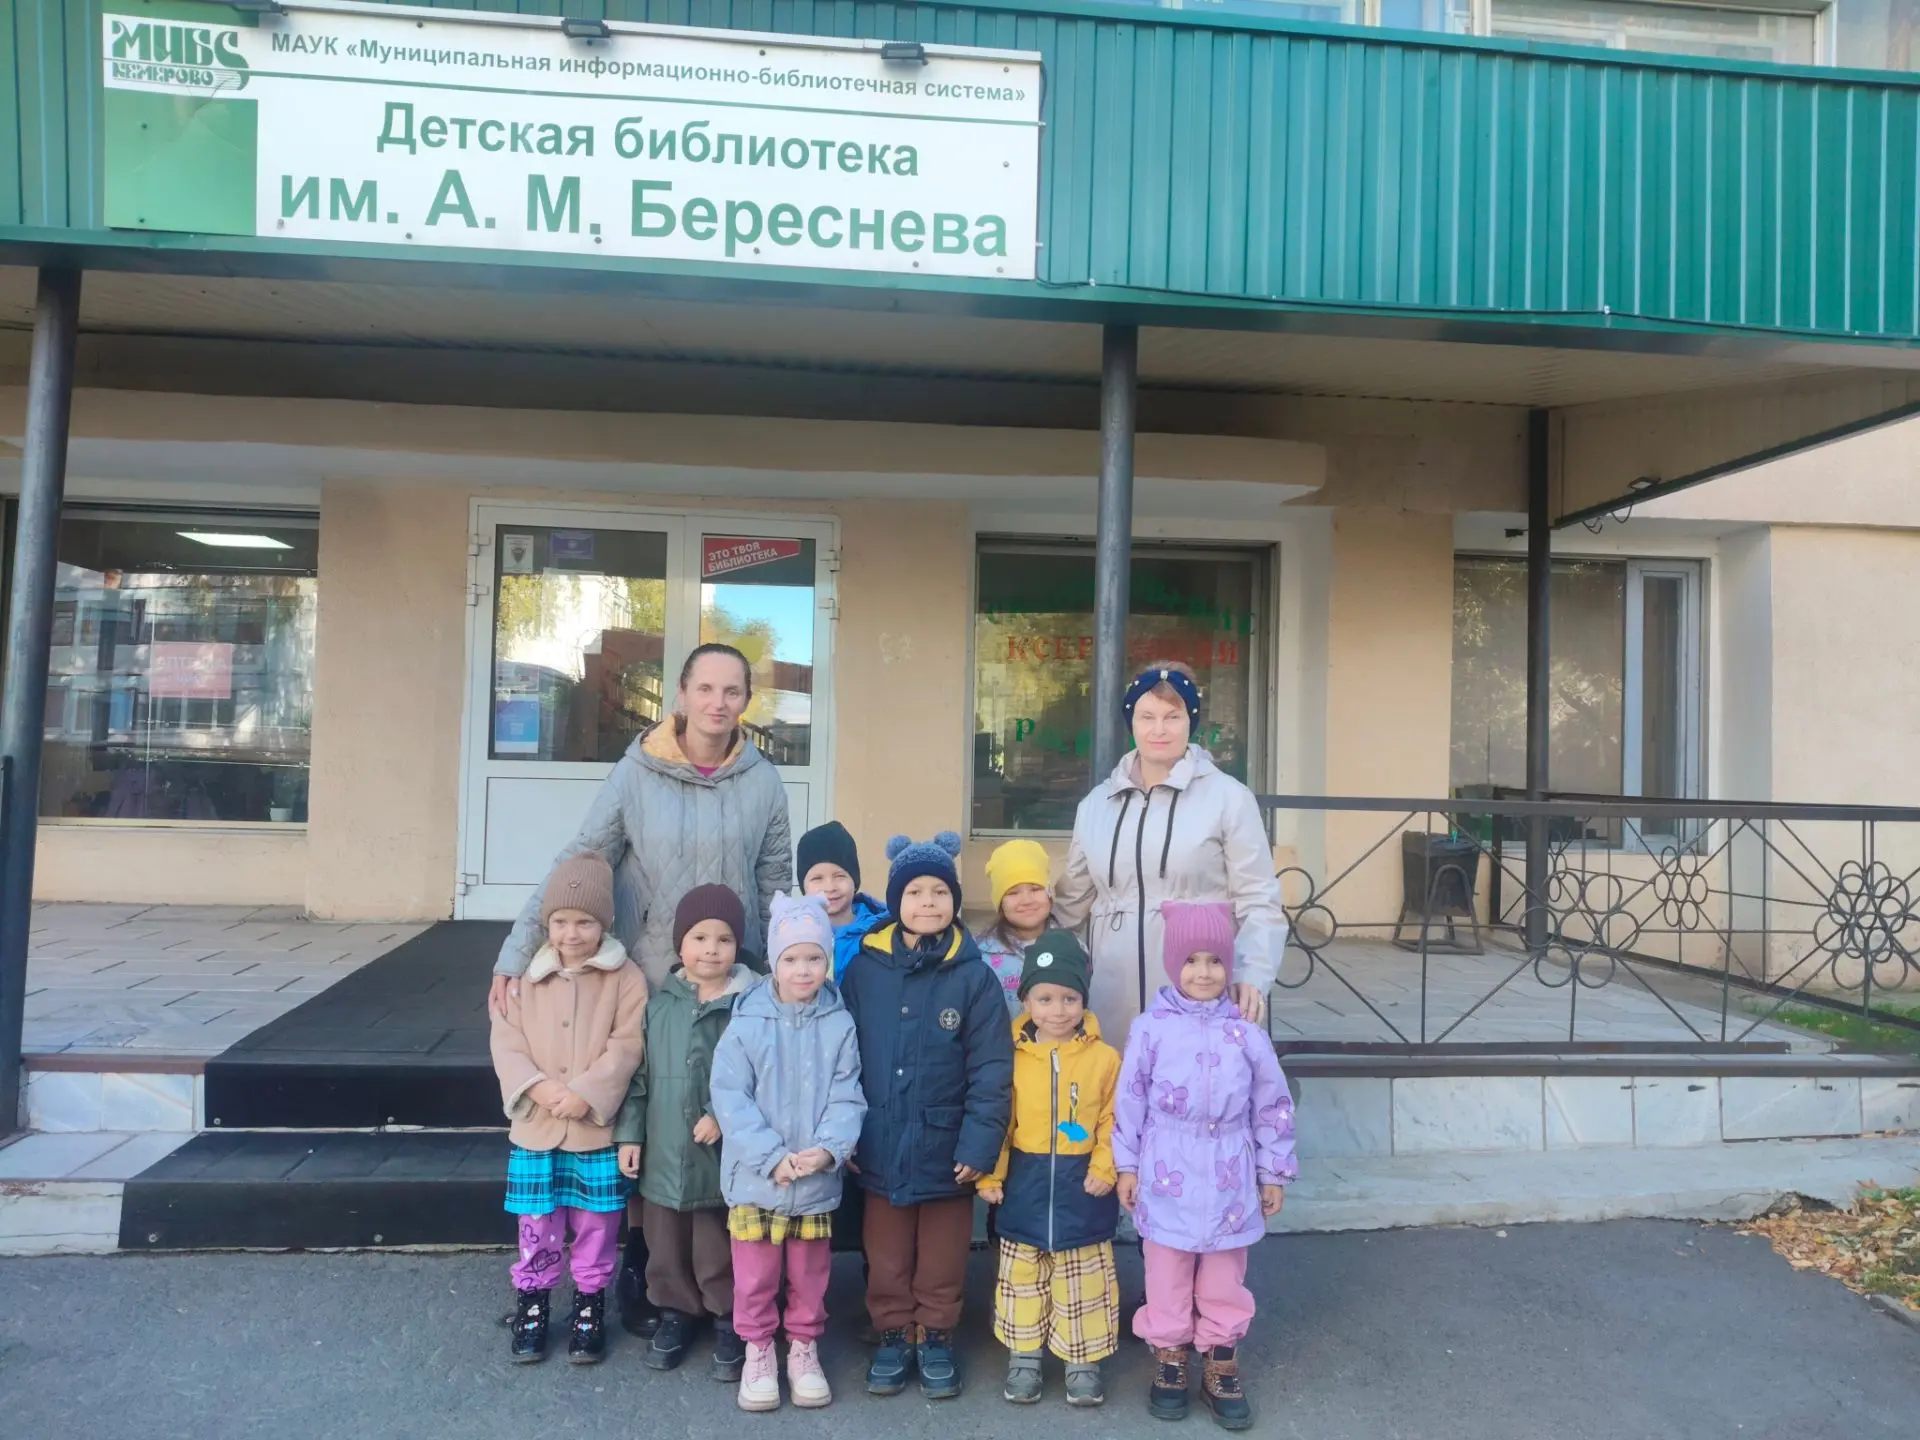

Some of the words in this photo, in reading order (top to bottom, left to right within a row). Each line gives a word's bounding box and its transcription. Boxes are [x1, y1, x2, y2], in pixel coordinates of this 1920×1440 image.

[272, 32, 339, 56] МАУК
[346, 39, 551, 72] «Муниципальная
[559, 56, 917, 96] информационно-библиотечная
[924, 83, 1026, 102] система»
[377, 102, 595, 157] Детская
[614, 116, 919, 177] библиотека
[281, 175, 399, 225] им.
[425, 169, 497, 229] А.
[527, 174, 601, 236] М.
[631, 180, 1007, 257] Береснева
[708, 548, 730, 562] ЭТО
[731, 541, 760, 555] ТВОЯ
[708, 548, 778, 572] БИБЛИОТЕКА
